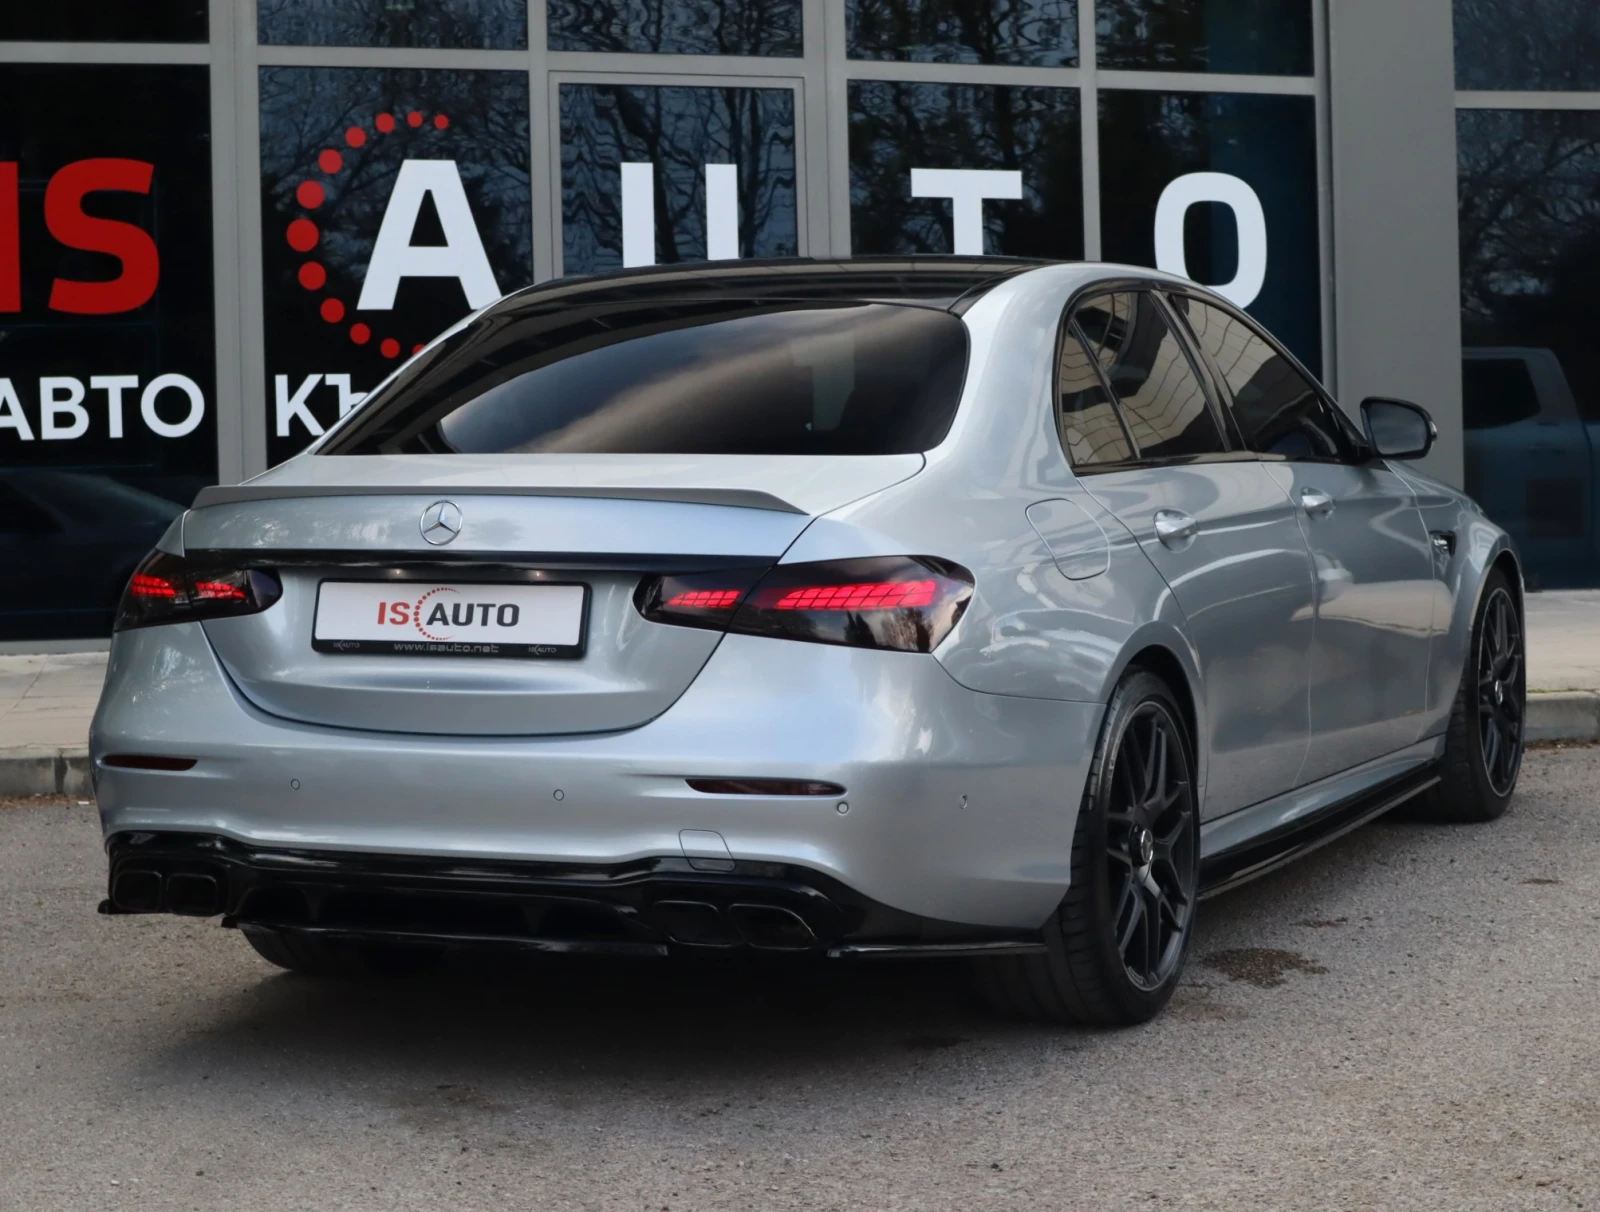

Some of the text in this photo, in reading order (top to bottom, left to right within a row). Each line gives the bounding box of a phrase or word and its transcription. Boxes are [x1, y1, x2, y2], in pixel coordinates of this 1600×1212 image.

[377, 601, 520, 627] IS AUTO
[394, 642, 500, 653] www.isauto.net
